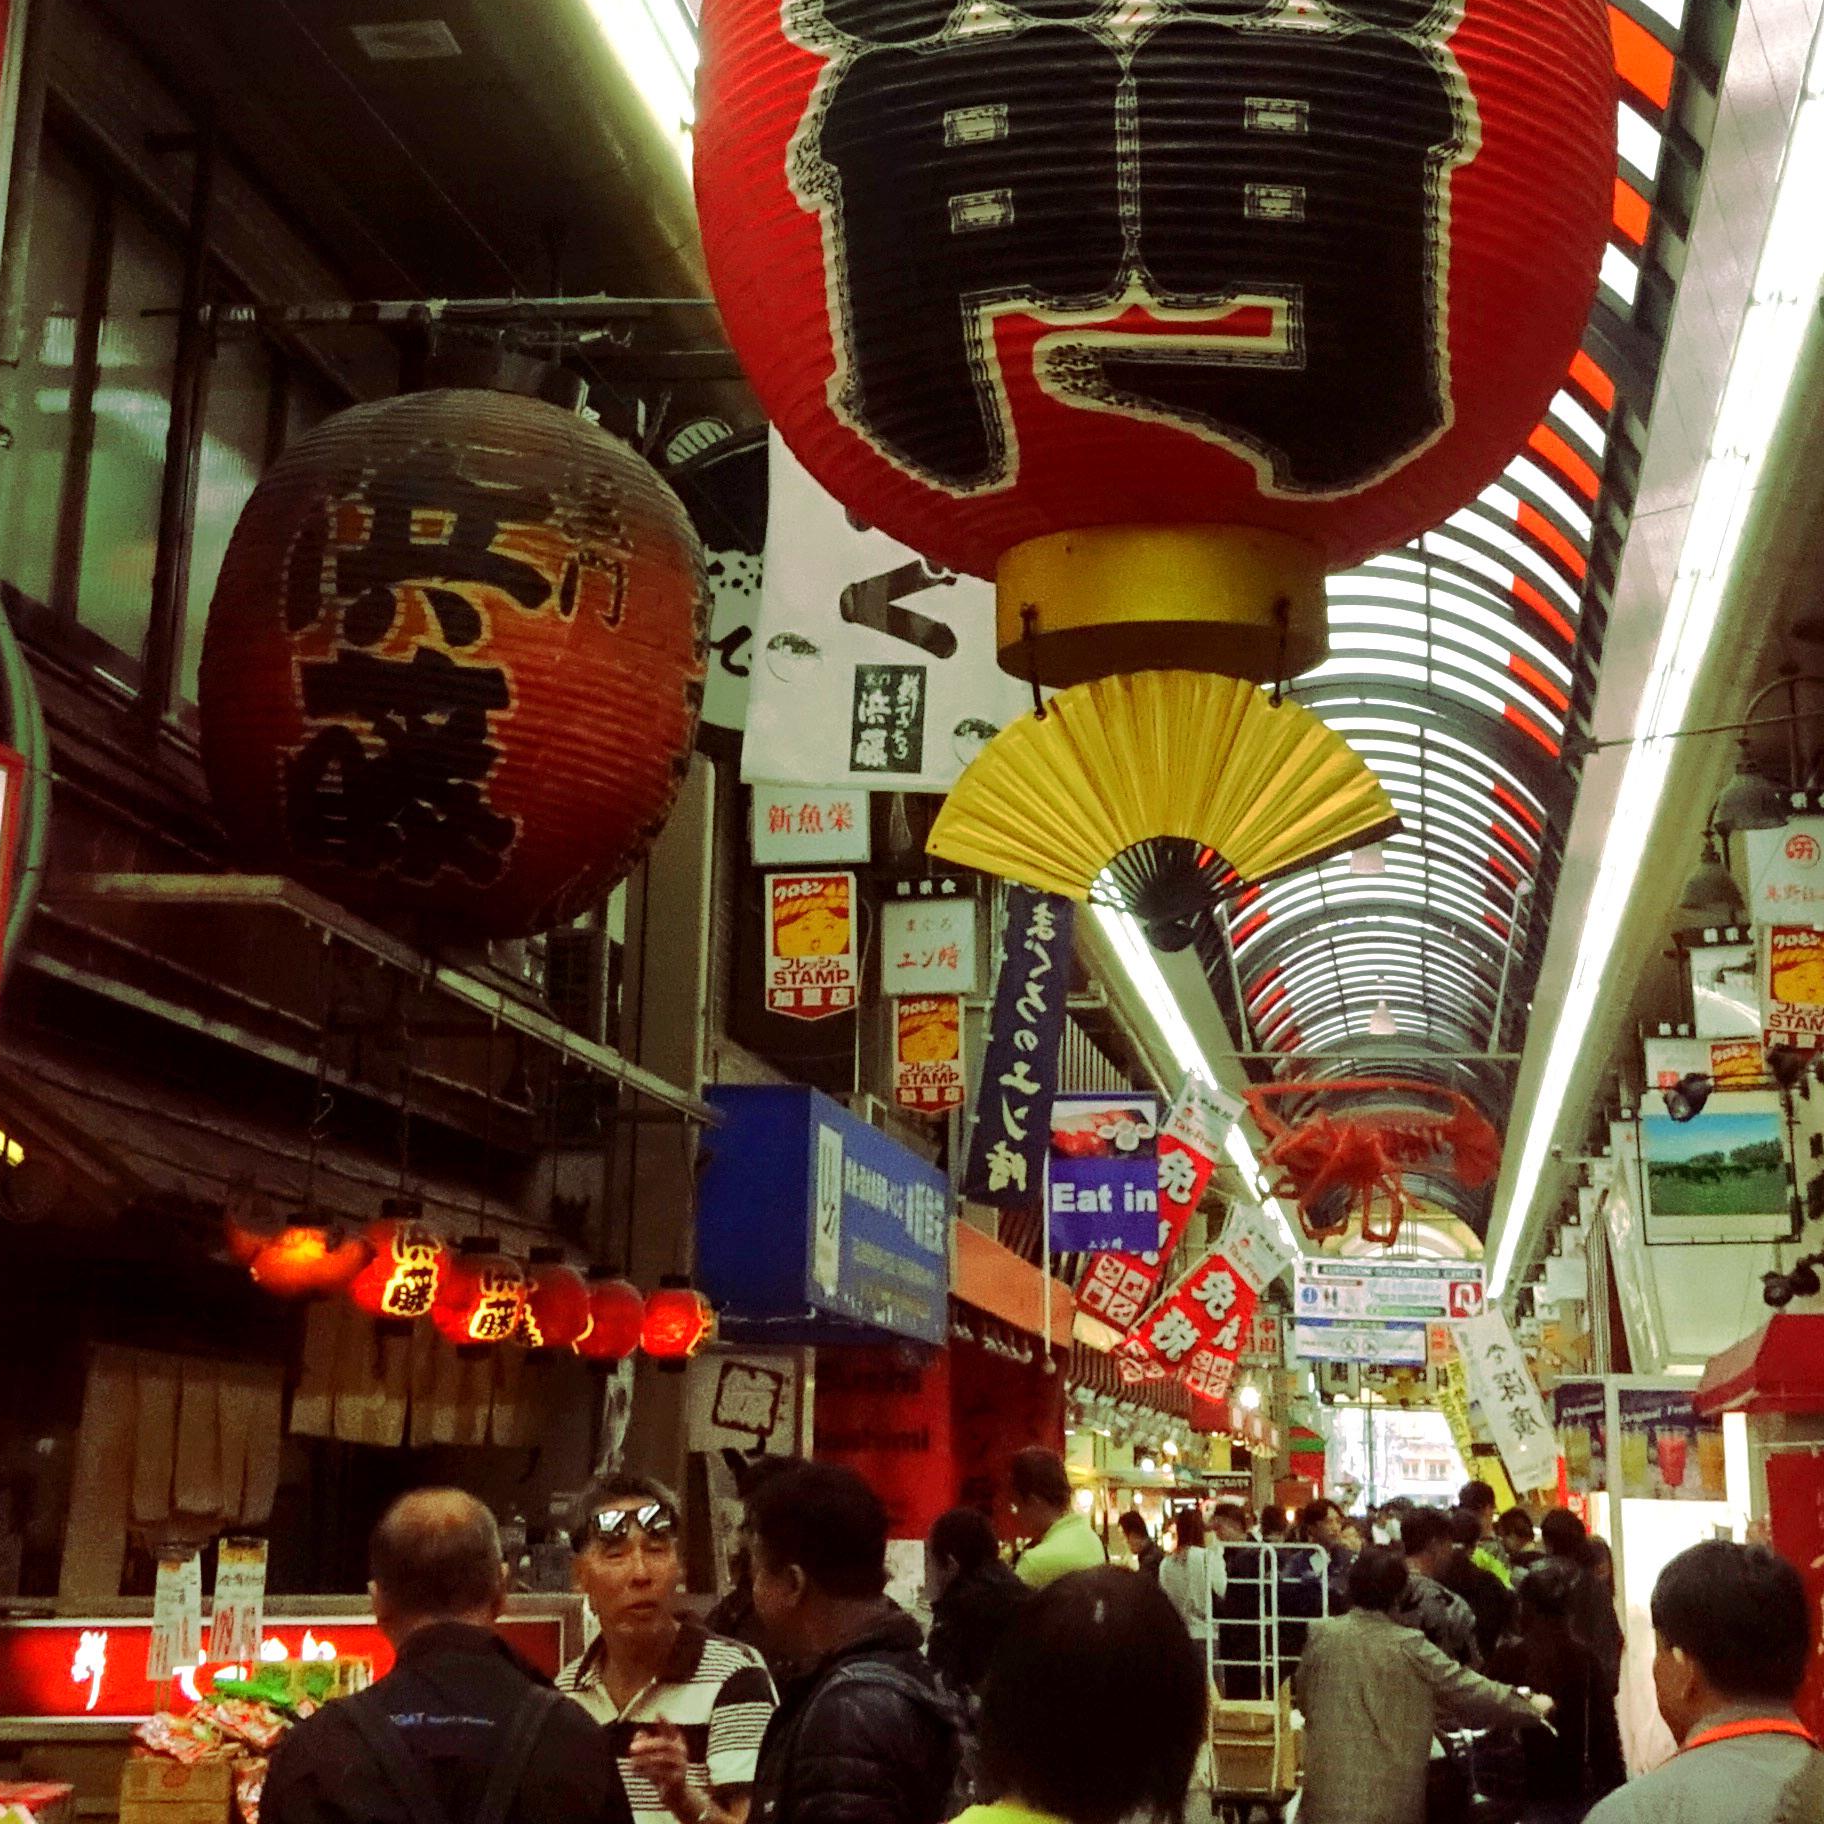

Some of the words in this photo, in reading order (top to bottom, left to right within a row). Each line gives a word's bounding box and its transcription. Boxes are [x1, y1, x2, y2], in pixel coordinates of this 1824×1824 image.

[775, 880, 825, 901] クロモン
[780, 956, 841, 970] フレッシュ
[773, 969, 851, 985] STAMP
[898, 1000, 940, 1017] クロモン
[898, 1072, 960, 1087] STAMP
[1052, 1182, 1113, 1213] Eat
[1124, 1182, 1158, 1213] in
